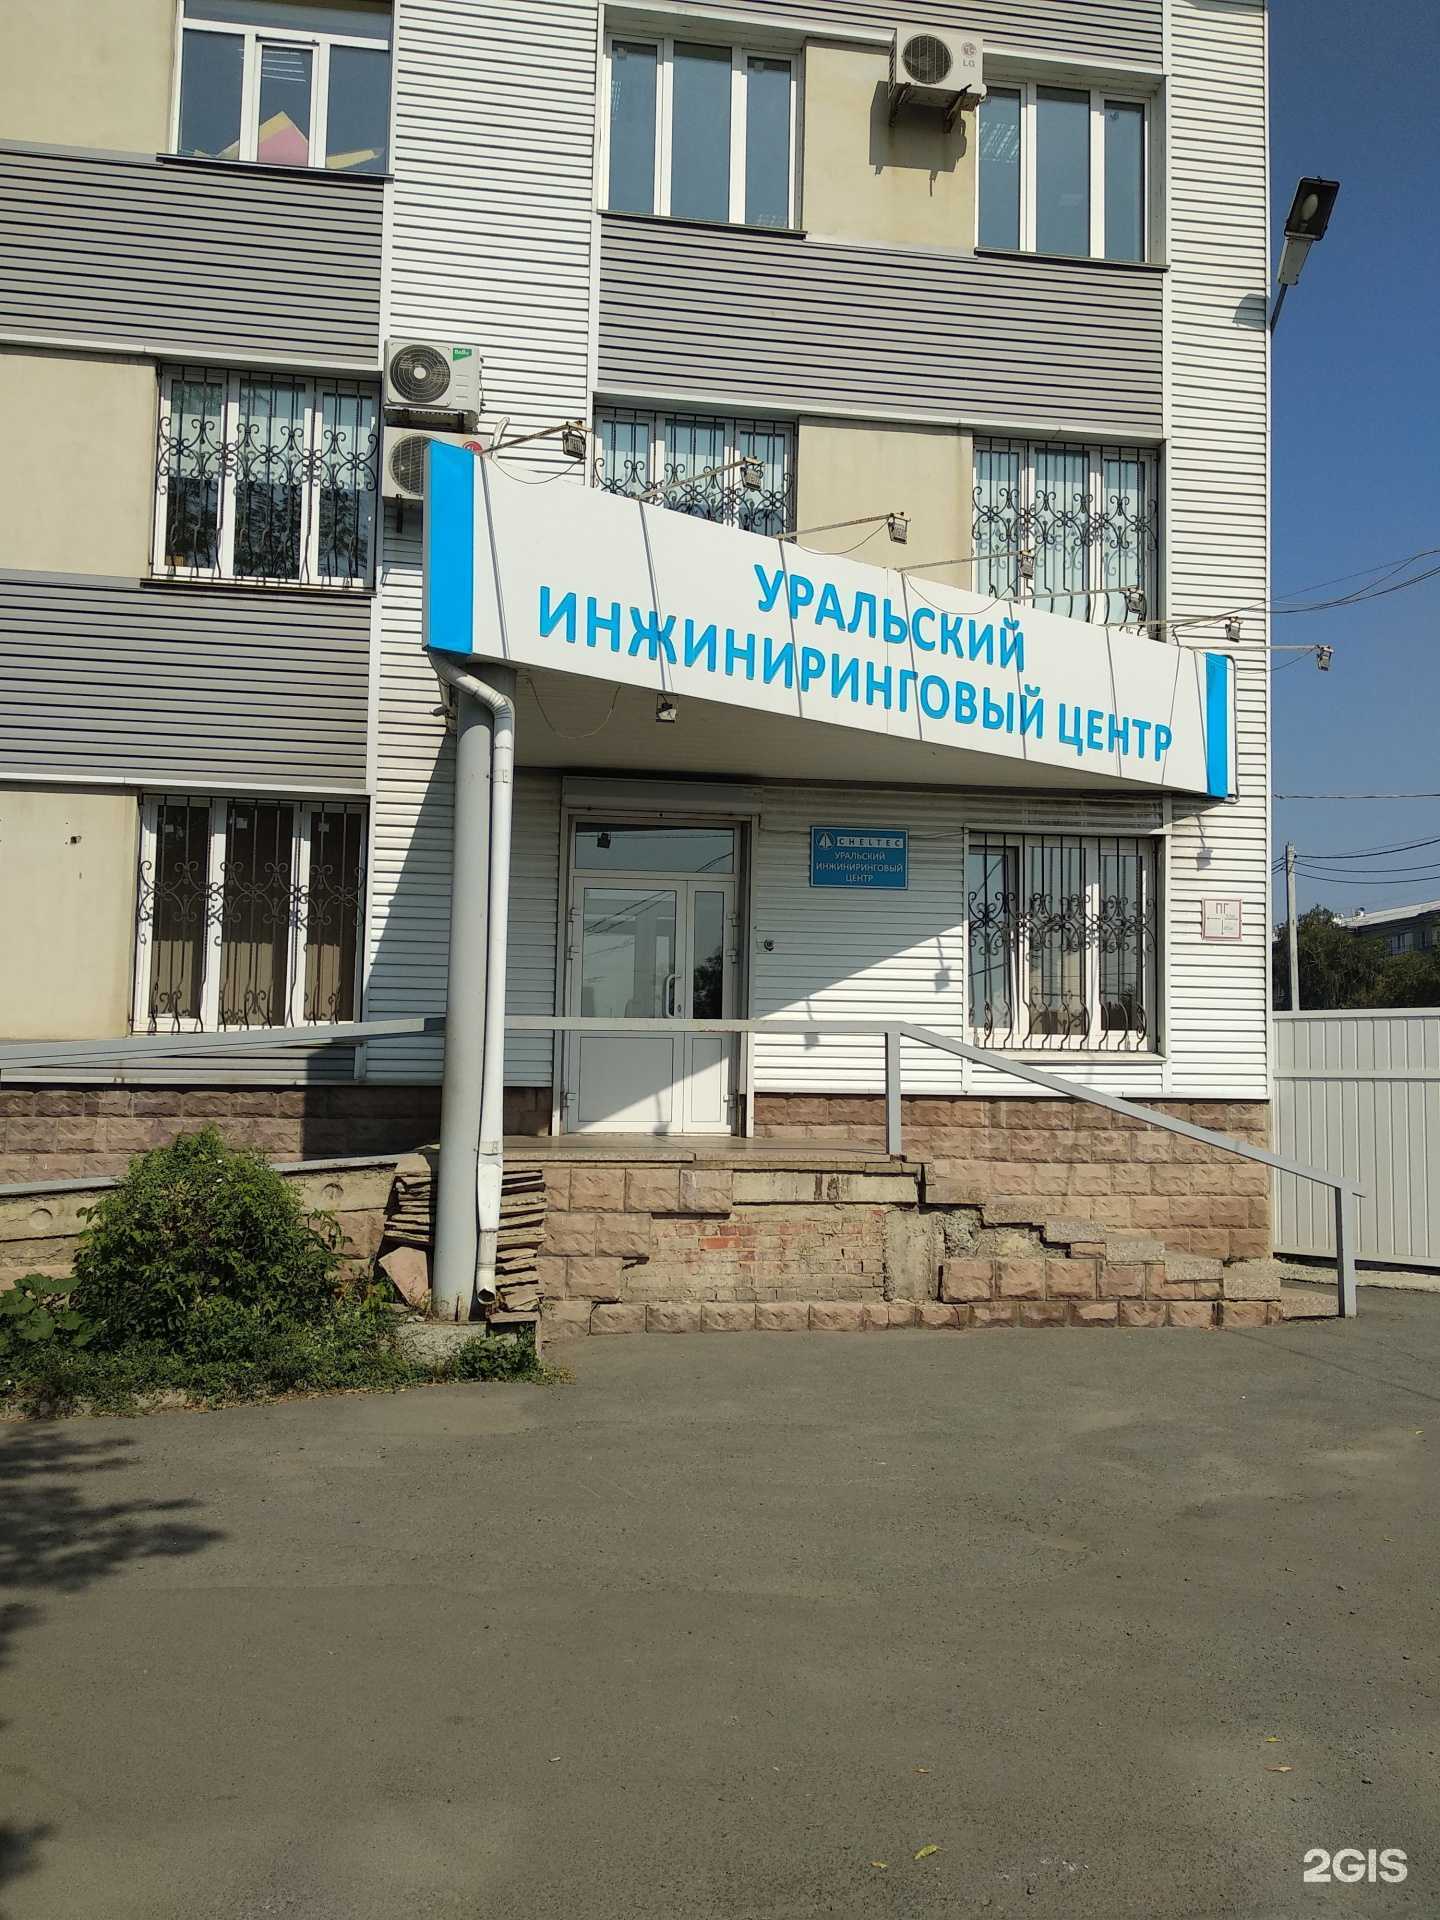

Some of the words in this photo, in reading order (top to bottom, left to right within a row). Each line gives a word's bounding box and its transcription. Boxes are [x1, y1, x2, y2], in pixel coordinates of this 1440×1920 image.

[755, 565, 1025, 672] УРАЛЬСКИЙ
[540, 586, 1044, 739] ИНЖИНИРИНГОВЫЙ
[1058, 703, 1173, 762] ЦЕНТР
[839, 838, 901, 848] CHELTEC
[834, 851, 886, 861] УРАЛЬСКИЙ
[816, 862, 903, 873] ИНЖИНИРИНГОВЫЙ
[845, 874, 874, 884] ЦЕНТР
